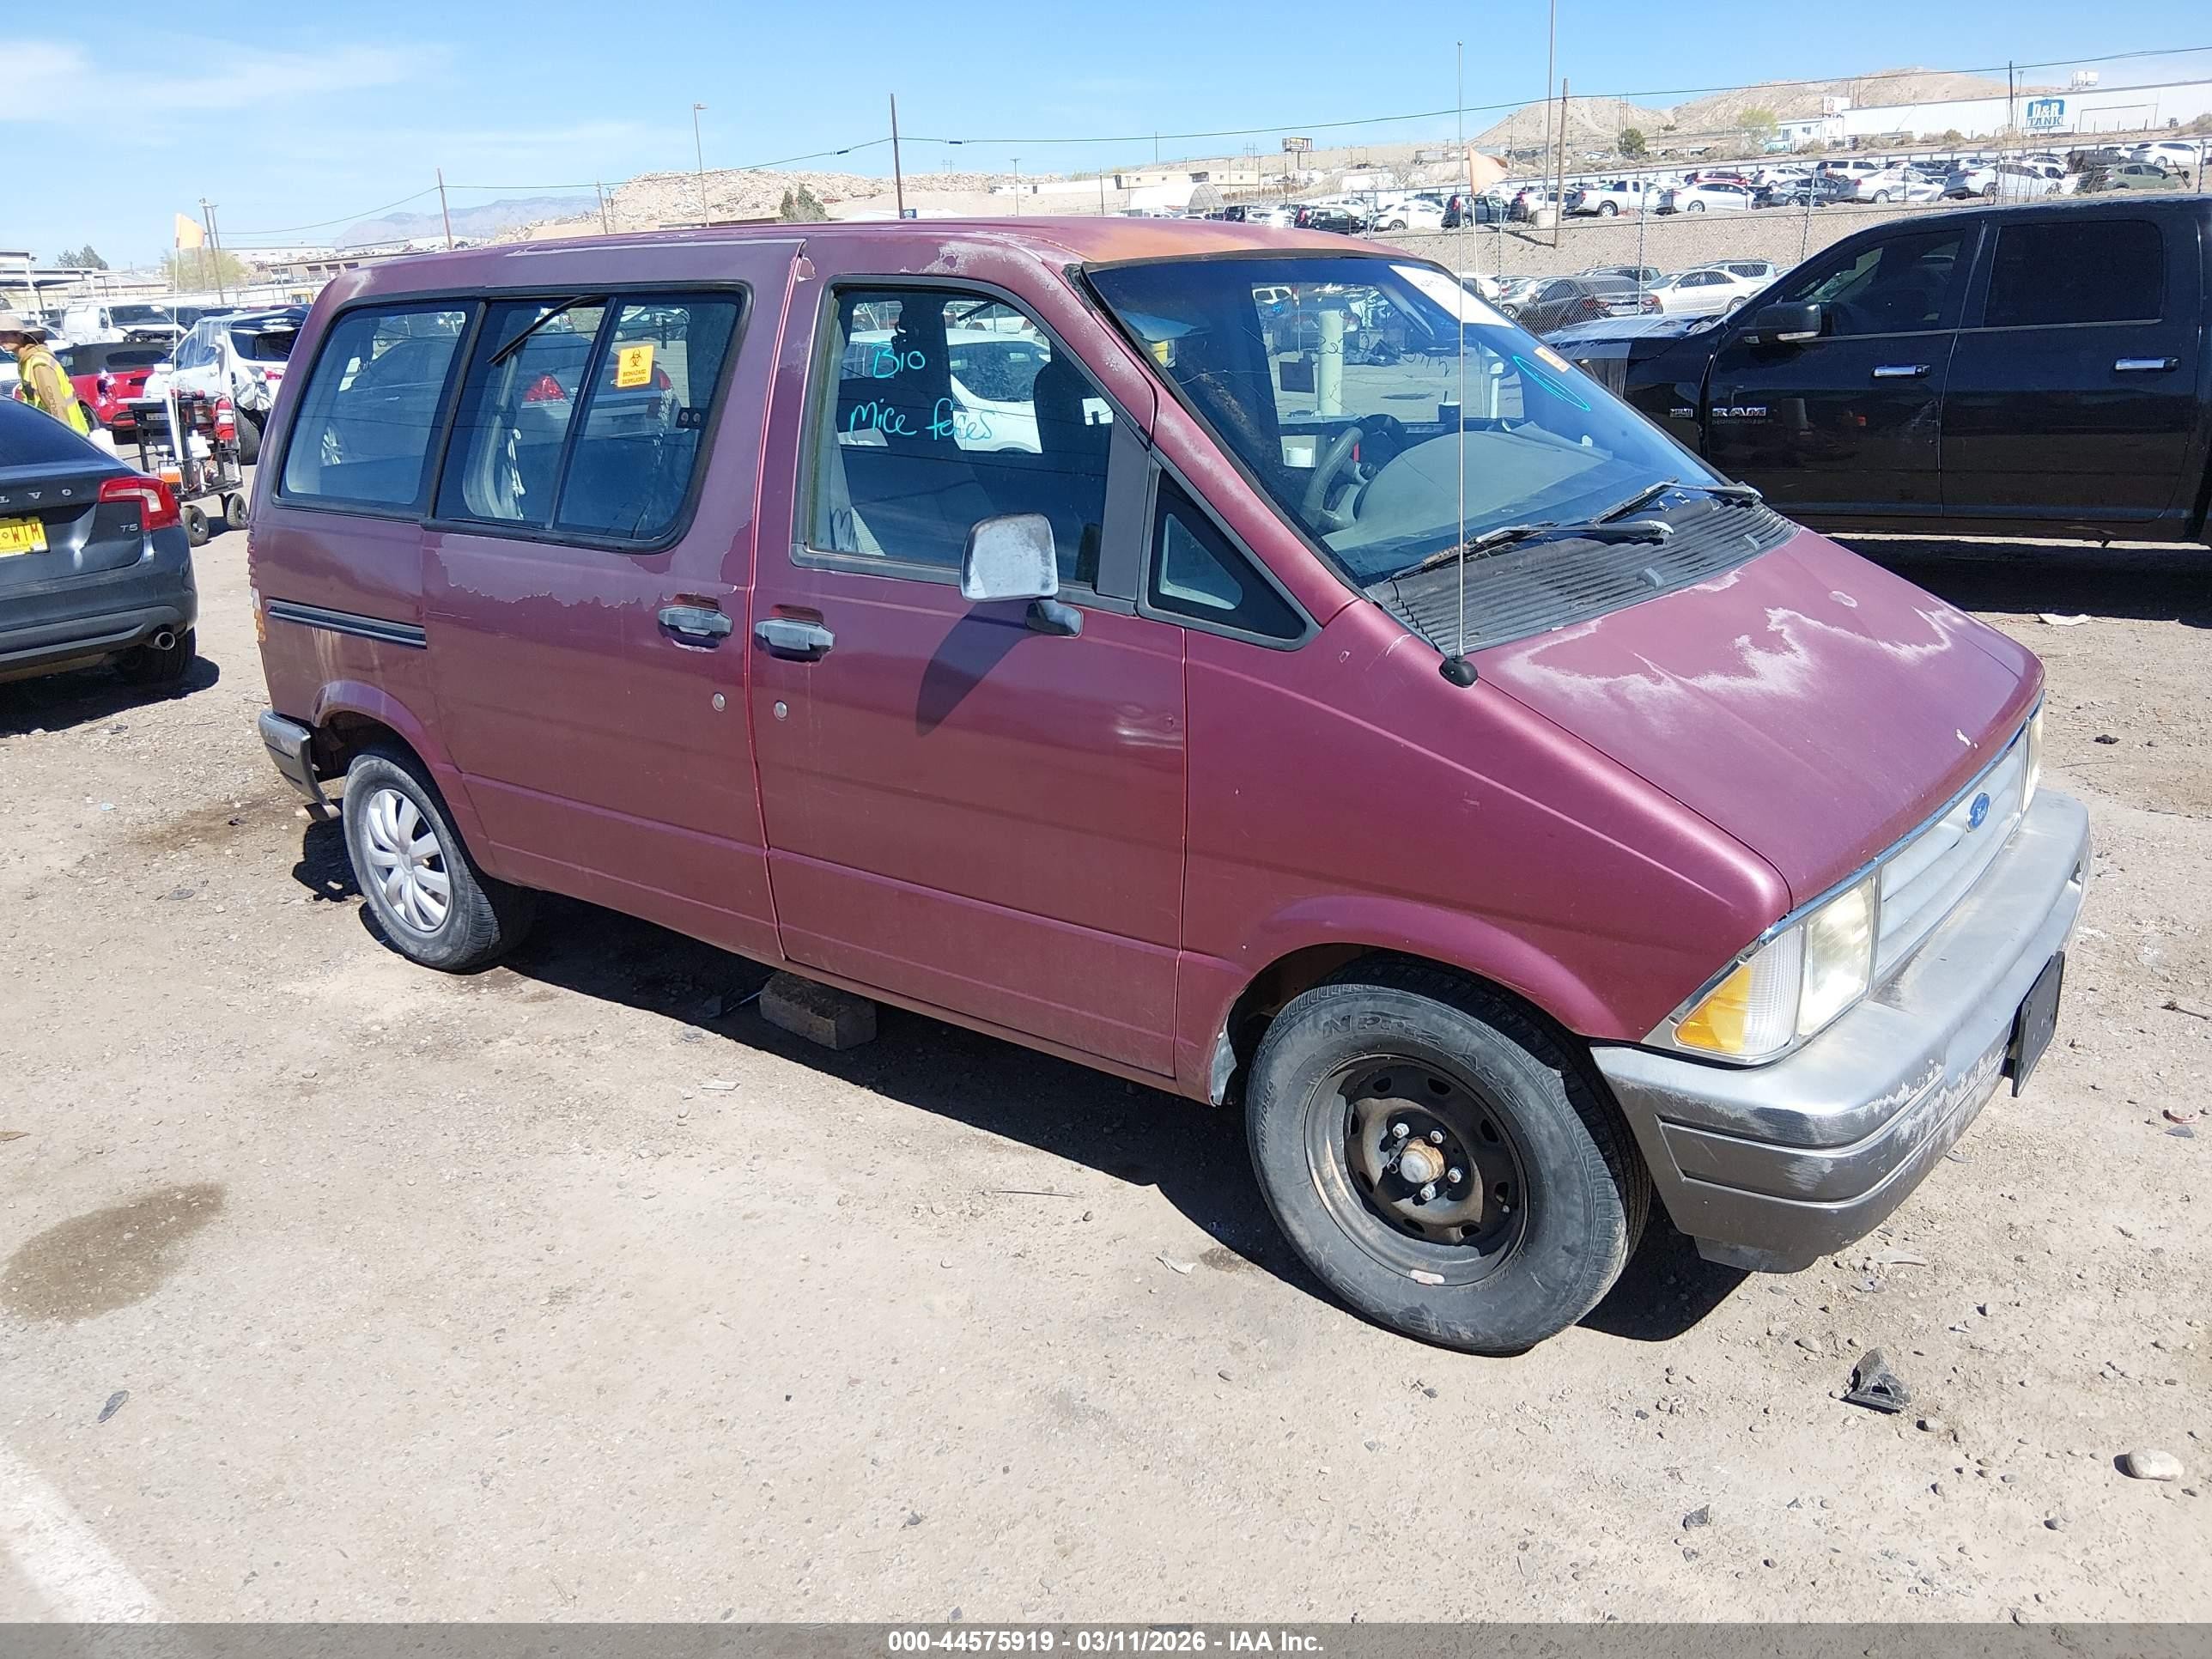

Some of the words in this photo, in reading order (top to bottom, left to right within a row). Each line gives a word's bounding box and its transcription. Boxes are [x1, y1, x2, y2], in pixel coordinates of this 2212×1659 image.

[2027, 116, 2063, 126] TANK
[1711, 407, 1767, 417] RAM
[119, 523, 139, 532] T5
